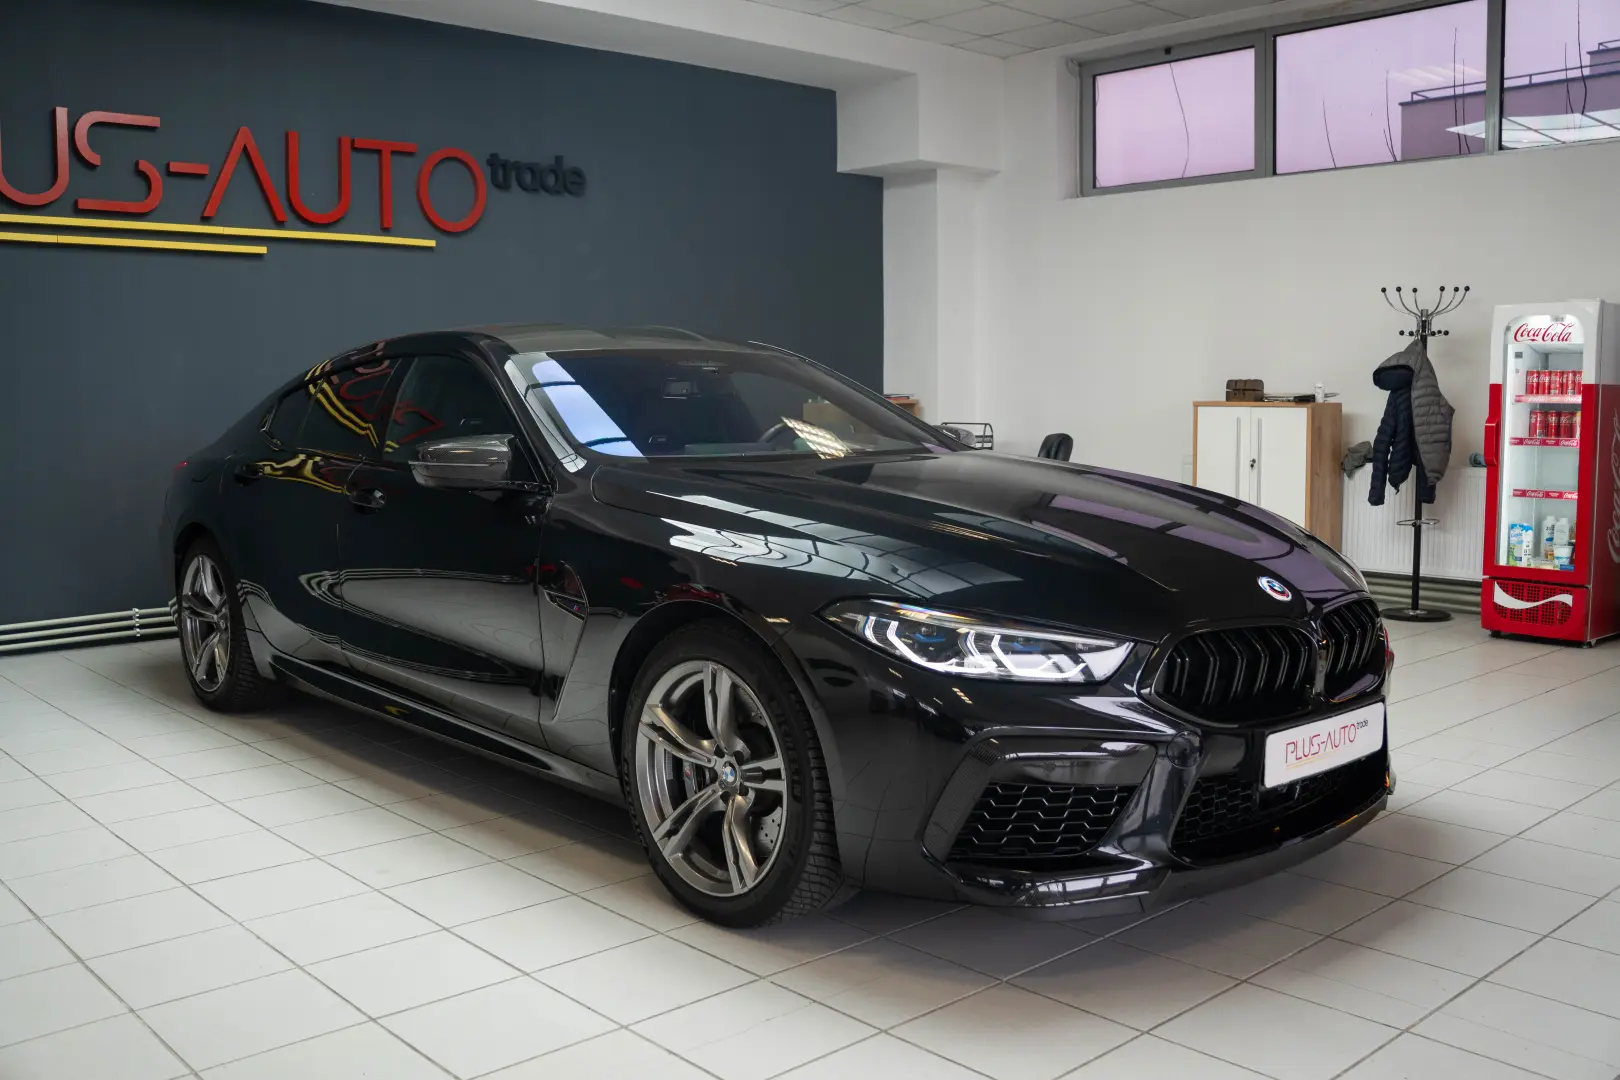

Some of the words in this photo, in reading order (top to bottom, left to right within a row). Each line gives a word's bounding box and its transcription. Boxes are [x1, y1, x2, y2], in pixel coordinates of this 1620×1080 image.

[486, 153, 588, 199] trade
[1513, 323, 1573, 342] Coca-Cola
[1286, 723, 1356, 764] PLUS-AUTO
[1356, 719, 1368, 730] trade
